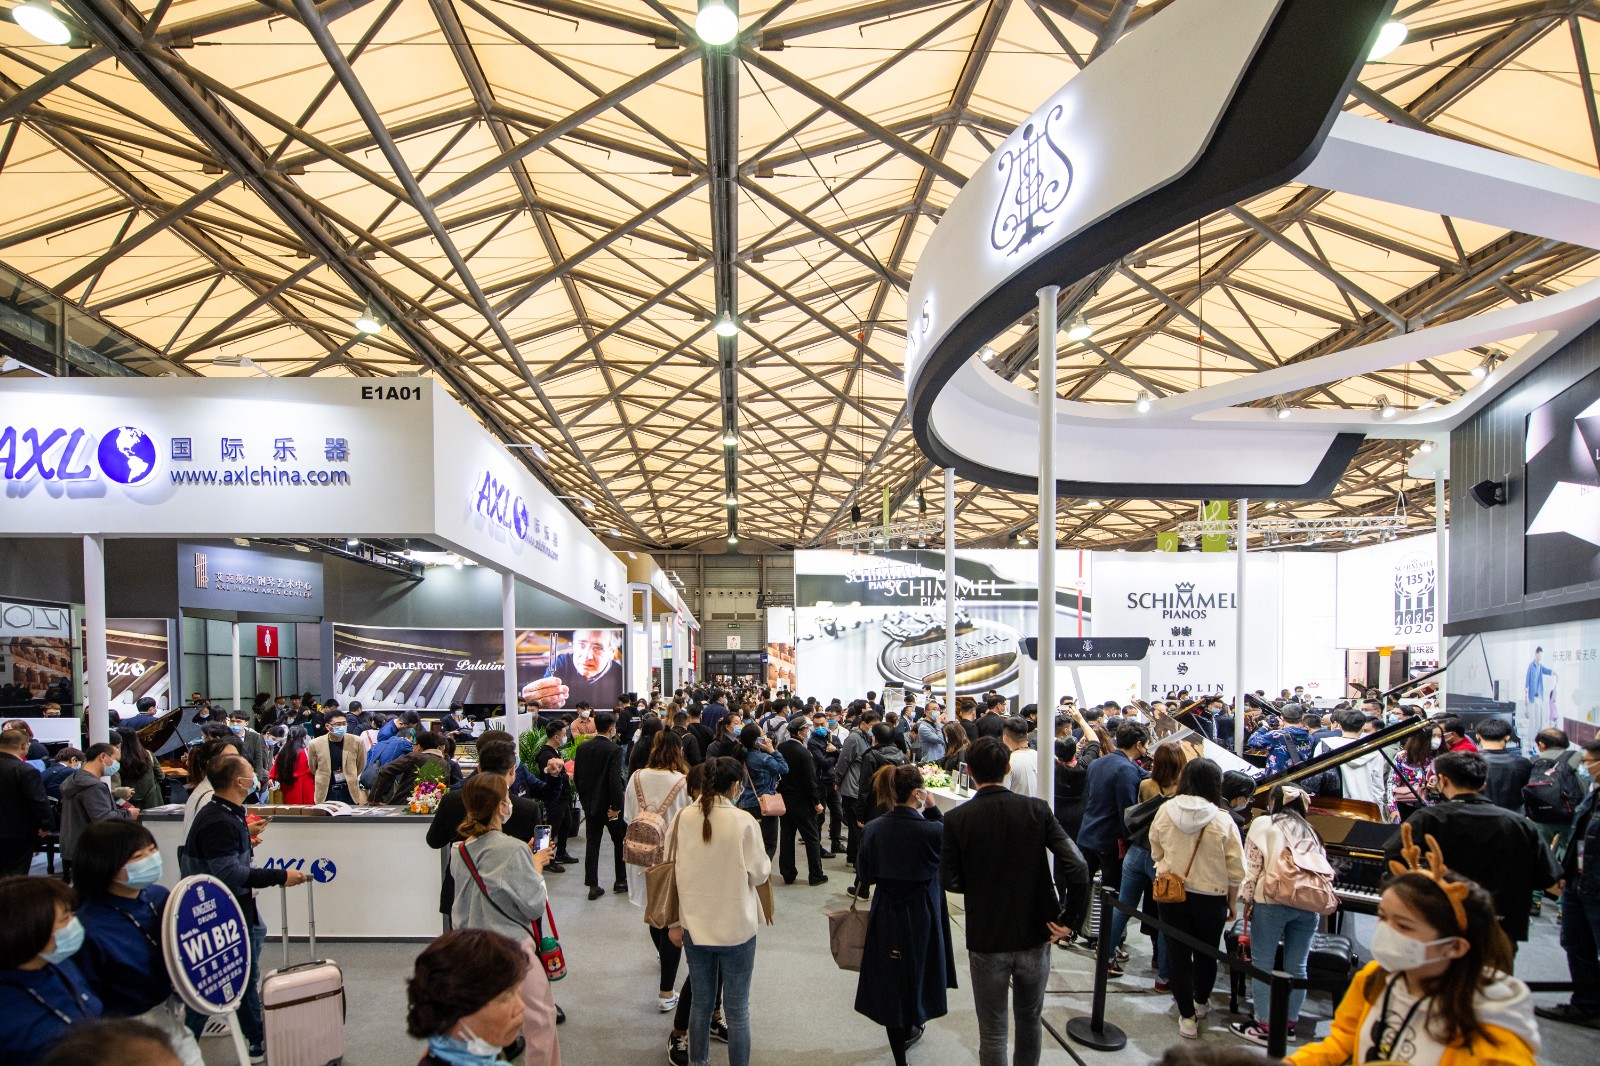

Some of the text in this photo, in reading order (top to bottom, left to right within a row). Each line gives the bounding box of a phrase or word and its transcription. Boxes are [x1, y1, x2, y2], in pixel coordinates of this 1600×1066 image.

[361, 386, 422, 401] E1A01
[171, 437, 350, 461] 国际乐器
[170, 466, 349, 484] www.axlchina.com
[477, 470, 512, 528] AXL
[1405, 573, 1424, 586] 135
[1127, 592, 1237, 609] SCHIMMEL
[1162, 609, 1207, 620] PIANOS
[1394, 623, 1435, 636] 2020
[1151, 683, 1224, 693] RIDOLIN
[198, 911, 218, 925] DRUMS
[182, 918, 241, 964] W1 B12
